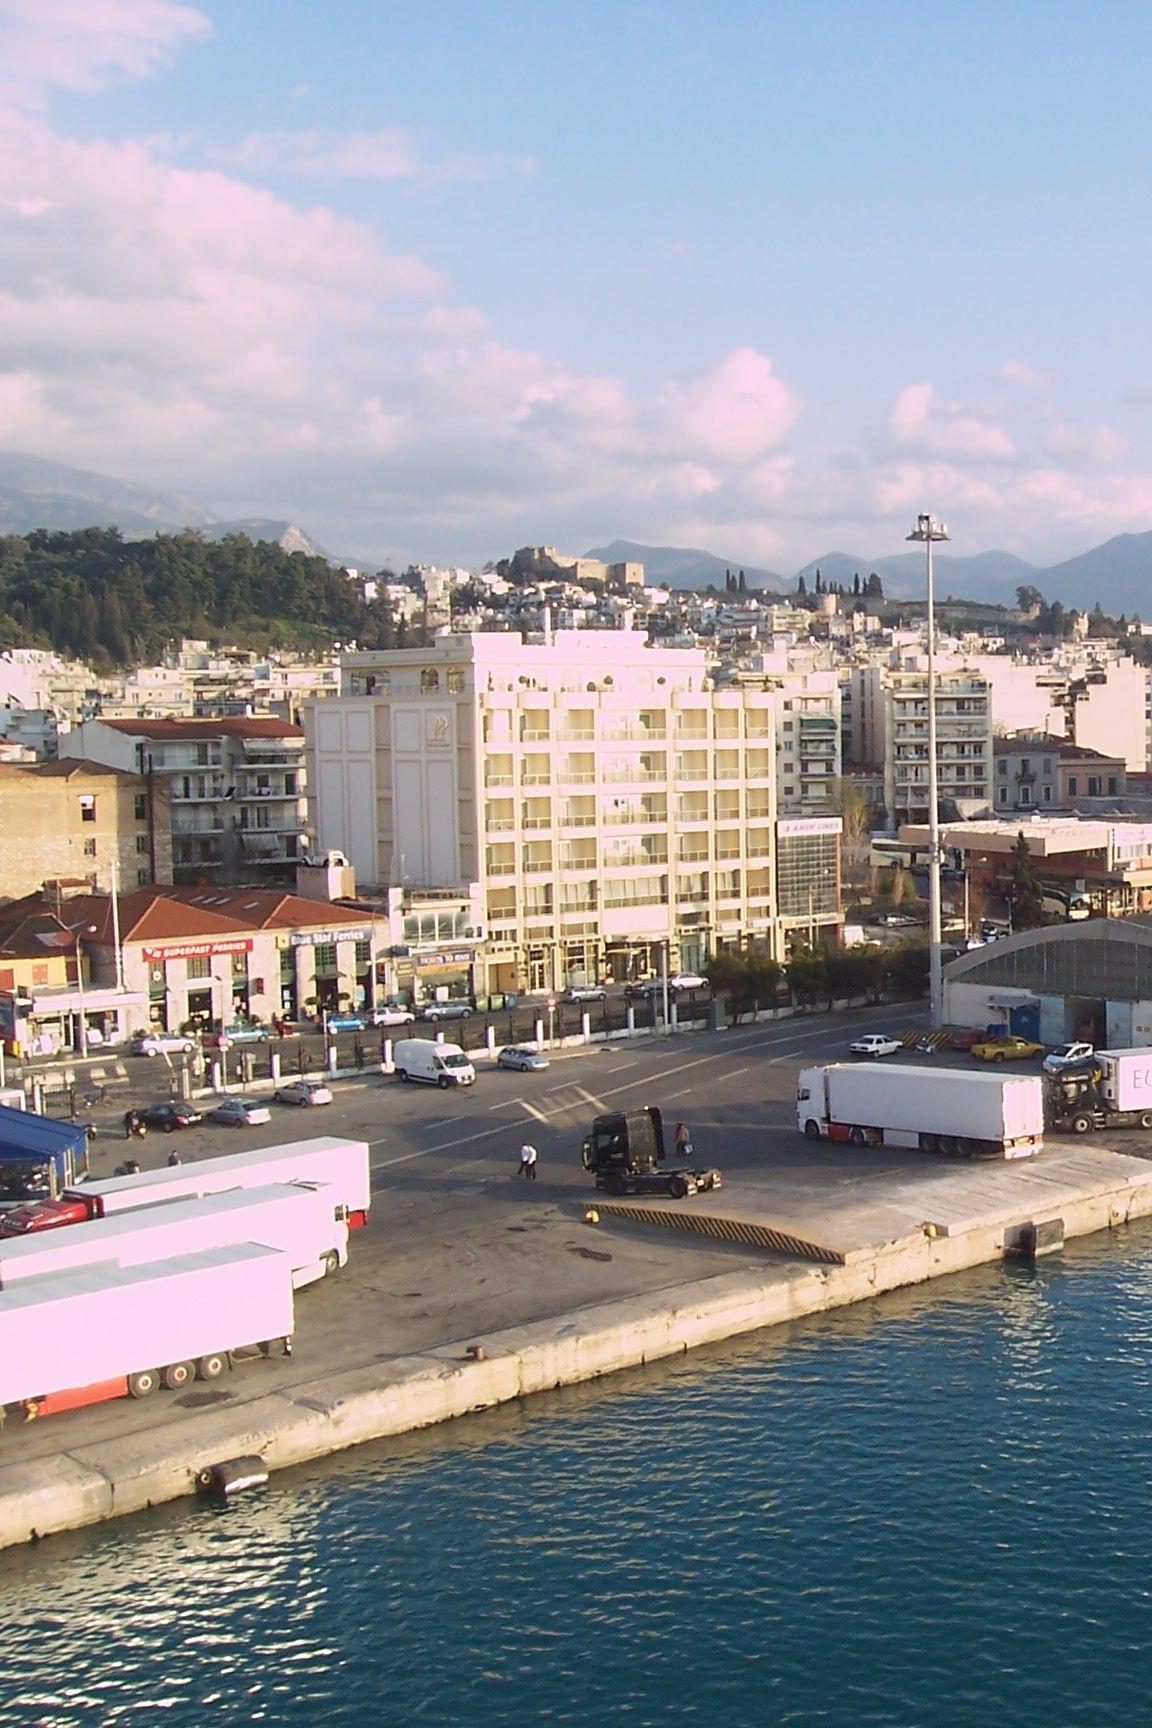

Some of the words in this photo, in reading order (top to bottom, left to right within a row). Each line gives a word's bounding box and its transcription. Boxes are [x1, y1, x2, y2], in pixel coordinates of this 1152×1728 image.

[290, 934, 312, 946] Blue
[313, 932, 332, 943] Star
[333, 930, 365, 942] Ferries
[163, 944, 211, 958] SUPERFAST
[212, 941, 247, 952] FERRIES
